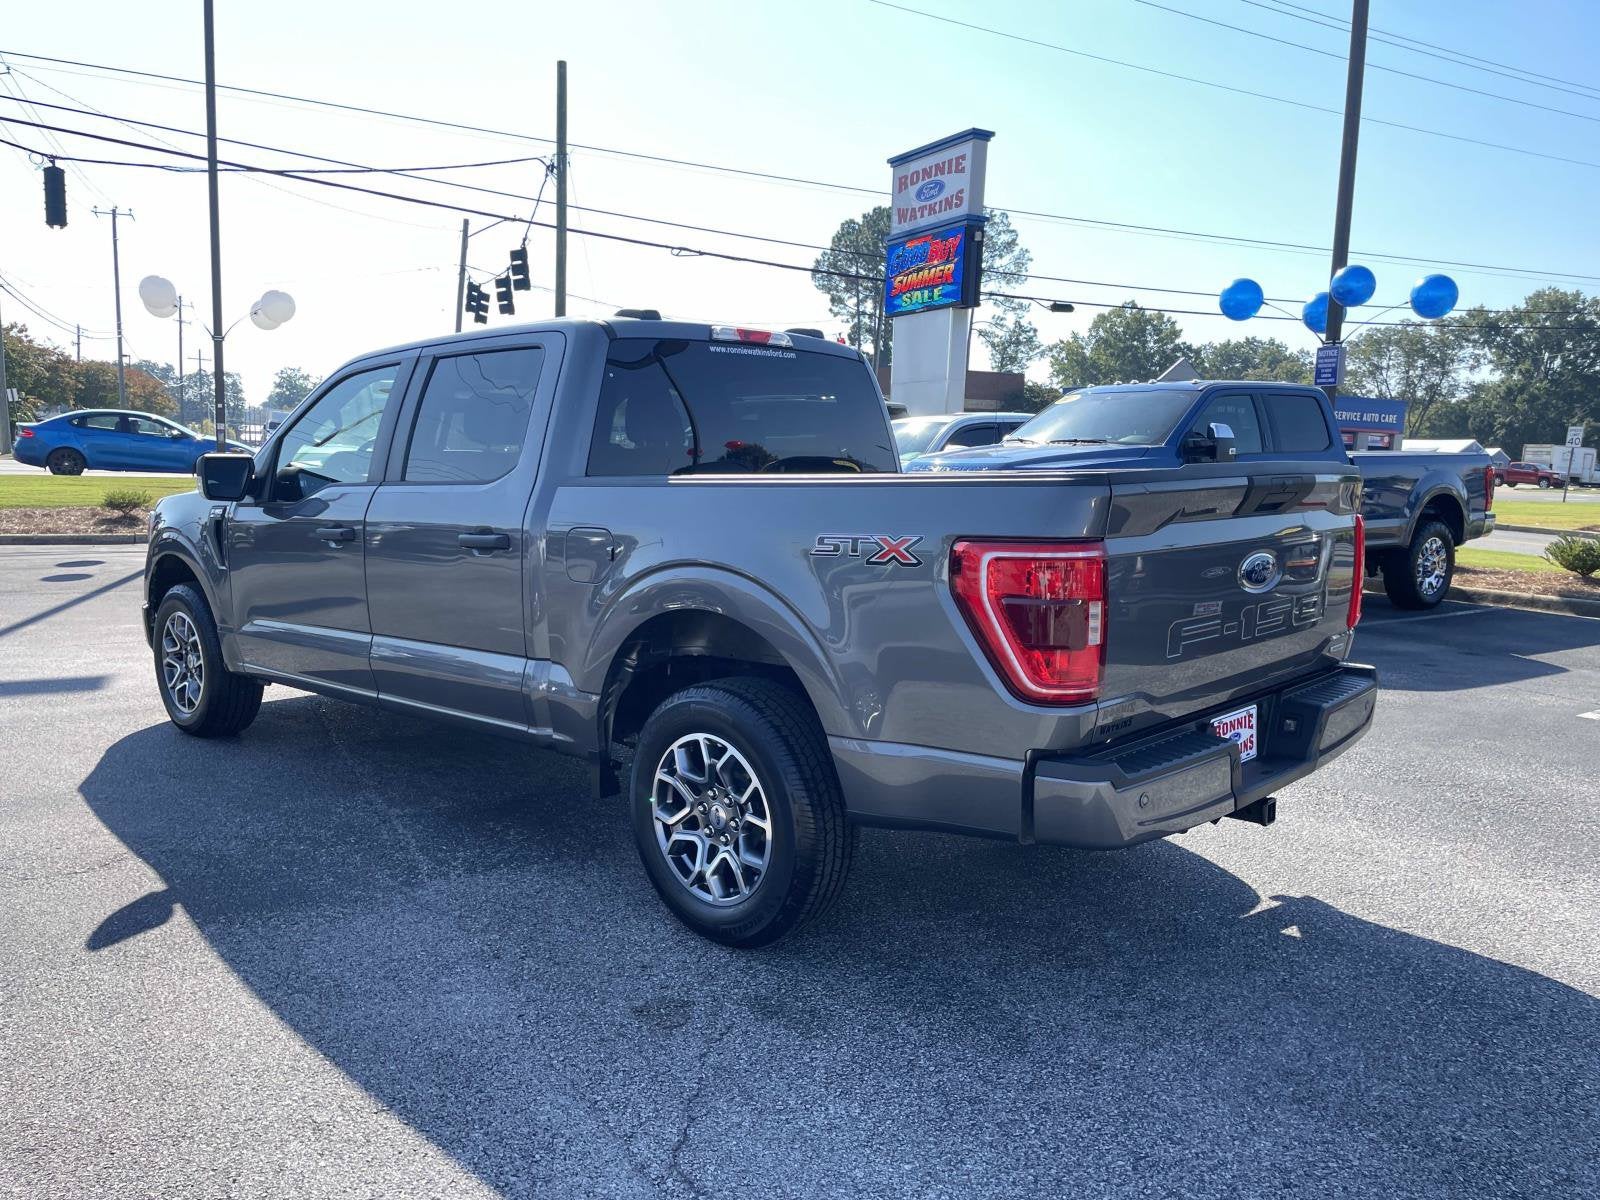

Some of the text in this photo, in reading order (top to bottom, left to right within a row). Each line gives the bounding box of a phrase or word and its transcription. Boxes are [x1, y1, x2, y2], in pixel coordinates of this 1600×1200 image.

[897, 154, 966, 192] RONNIE
[897, 189, 965, 224] WATKINS
[927, 235, 961, 263] BUY
[890, 264, 955, 297] SUMMER
[902, 286, 943, 307] SALE
[709, 345, 797, 359] www.ronniewatkinsford.com
[1334, 411, 1398, 424] SERVICE AUTO CARE
[1567, 437, 1581, 446] 40
[809, 533, 925, 568] STX
[1166, 594, 1326, 659] F-150
